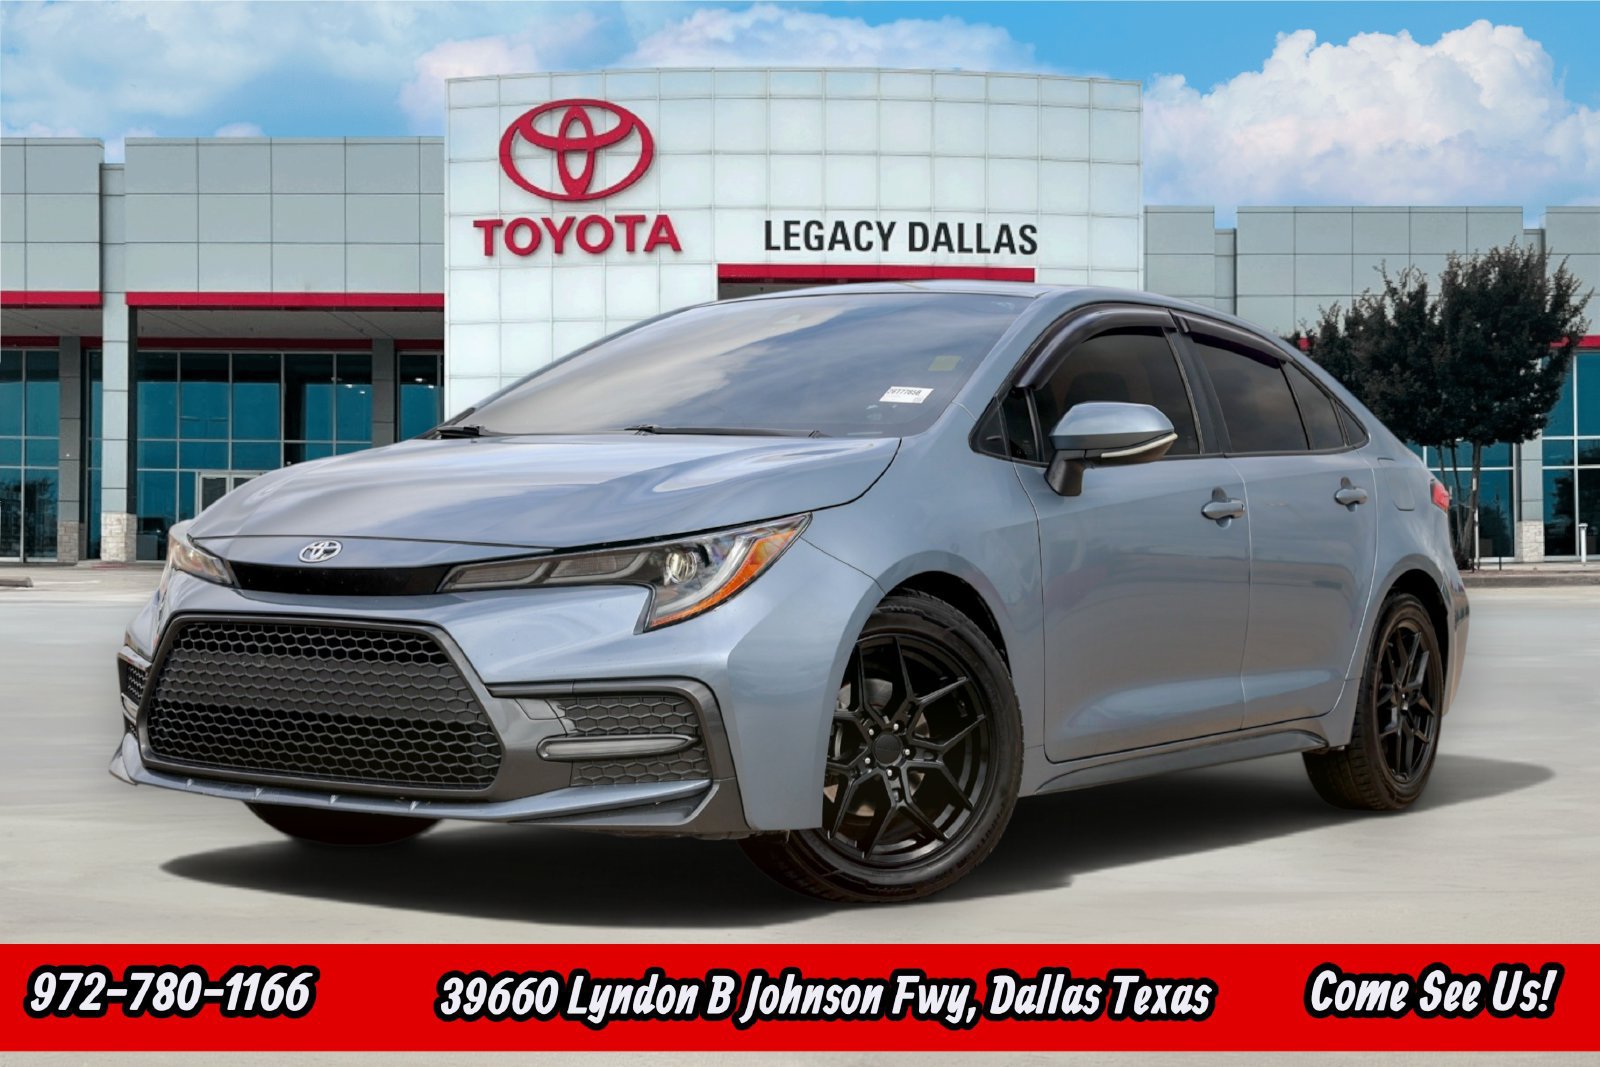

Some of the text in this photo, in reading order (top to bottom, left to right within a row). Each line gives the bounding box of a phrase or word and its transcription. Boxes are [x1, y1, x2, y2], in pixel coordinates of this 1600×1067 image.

[473, 213, 682, 257] TOYOTA
[765, 220, 1038, 255] LEGACY DALLAS
